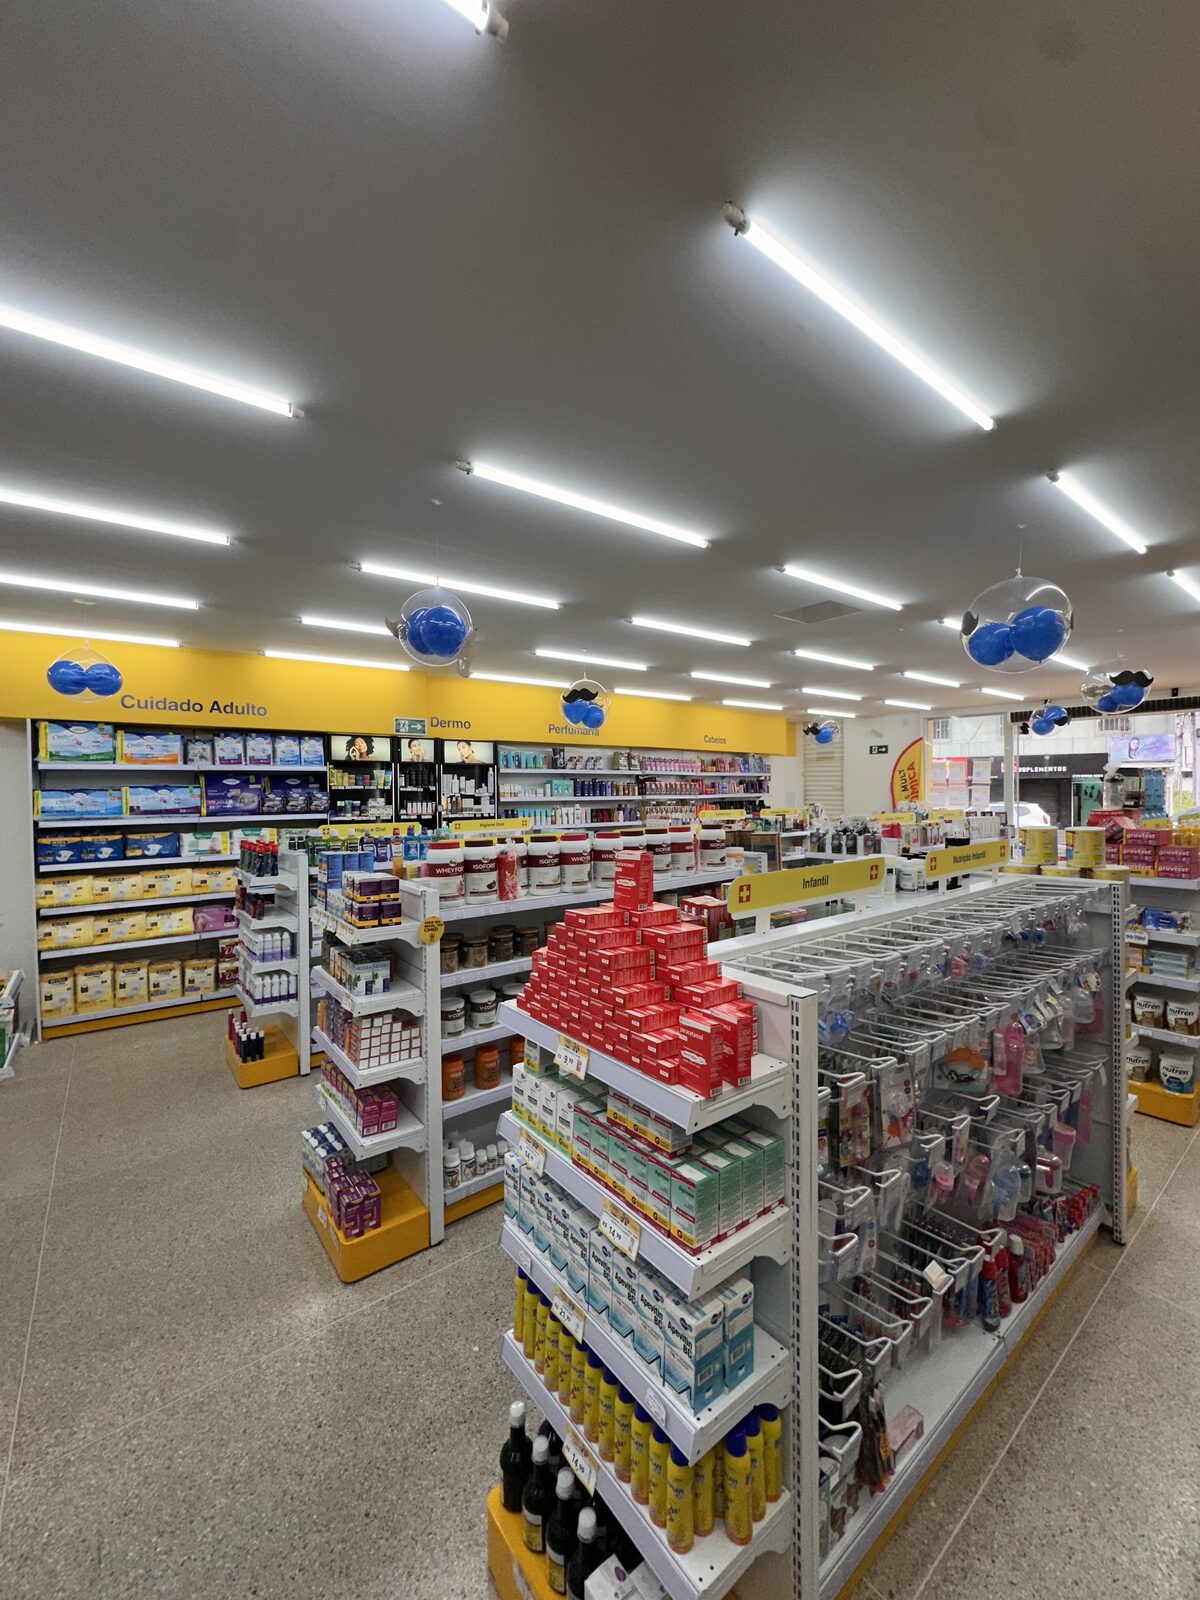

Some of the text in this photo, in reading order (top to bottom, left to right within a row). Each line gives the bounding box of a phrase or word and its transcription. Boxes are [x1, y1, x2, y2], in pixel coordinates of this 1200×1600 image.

[120, 694, 268, 716] Cuidado Adulto
[430, 716, 471, 729] Dermo
[704, 734, 726, 745] Cabelos
[802, 875, 829, 889] Infantil
[1136, 1001, 1161, 1010] nutren
[1169, 1006, 1194, 1017] nutren
[564, 1055, 574, 1065] 9,99
[1162, 1064, 1189, 1076] nutren
[653, 1212, 658, 1220] G
[609, 1226, 622, 1240] 14,99
[677, 1230, 683, 1238] G
[592, 1251, 611, 1274] Apevitin
[603, 1270, 611, 1282] BC
[615, 1272, 636, 1296] Apevitin
[628, 1293, 636, 1305] BC
[640, 1294, 663, 1320] Apevitin
[654, 1317, 663, 1330] BC
[668, 1321, 693, 1350] Apevitin
[683, 1345, 693, 1359] BC
